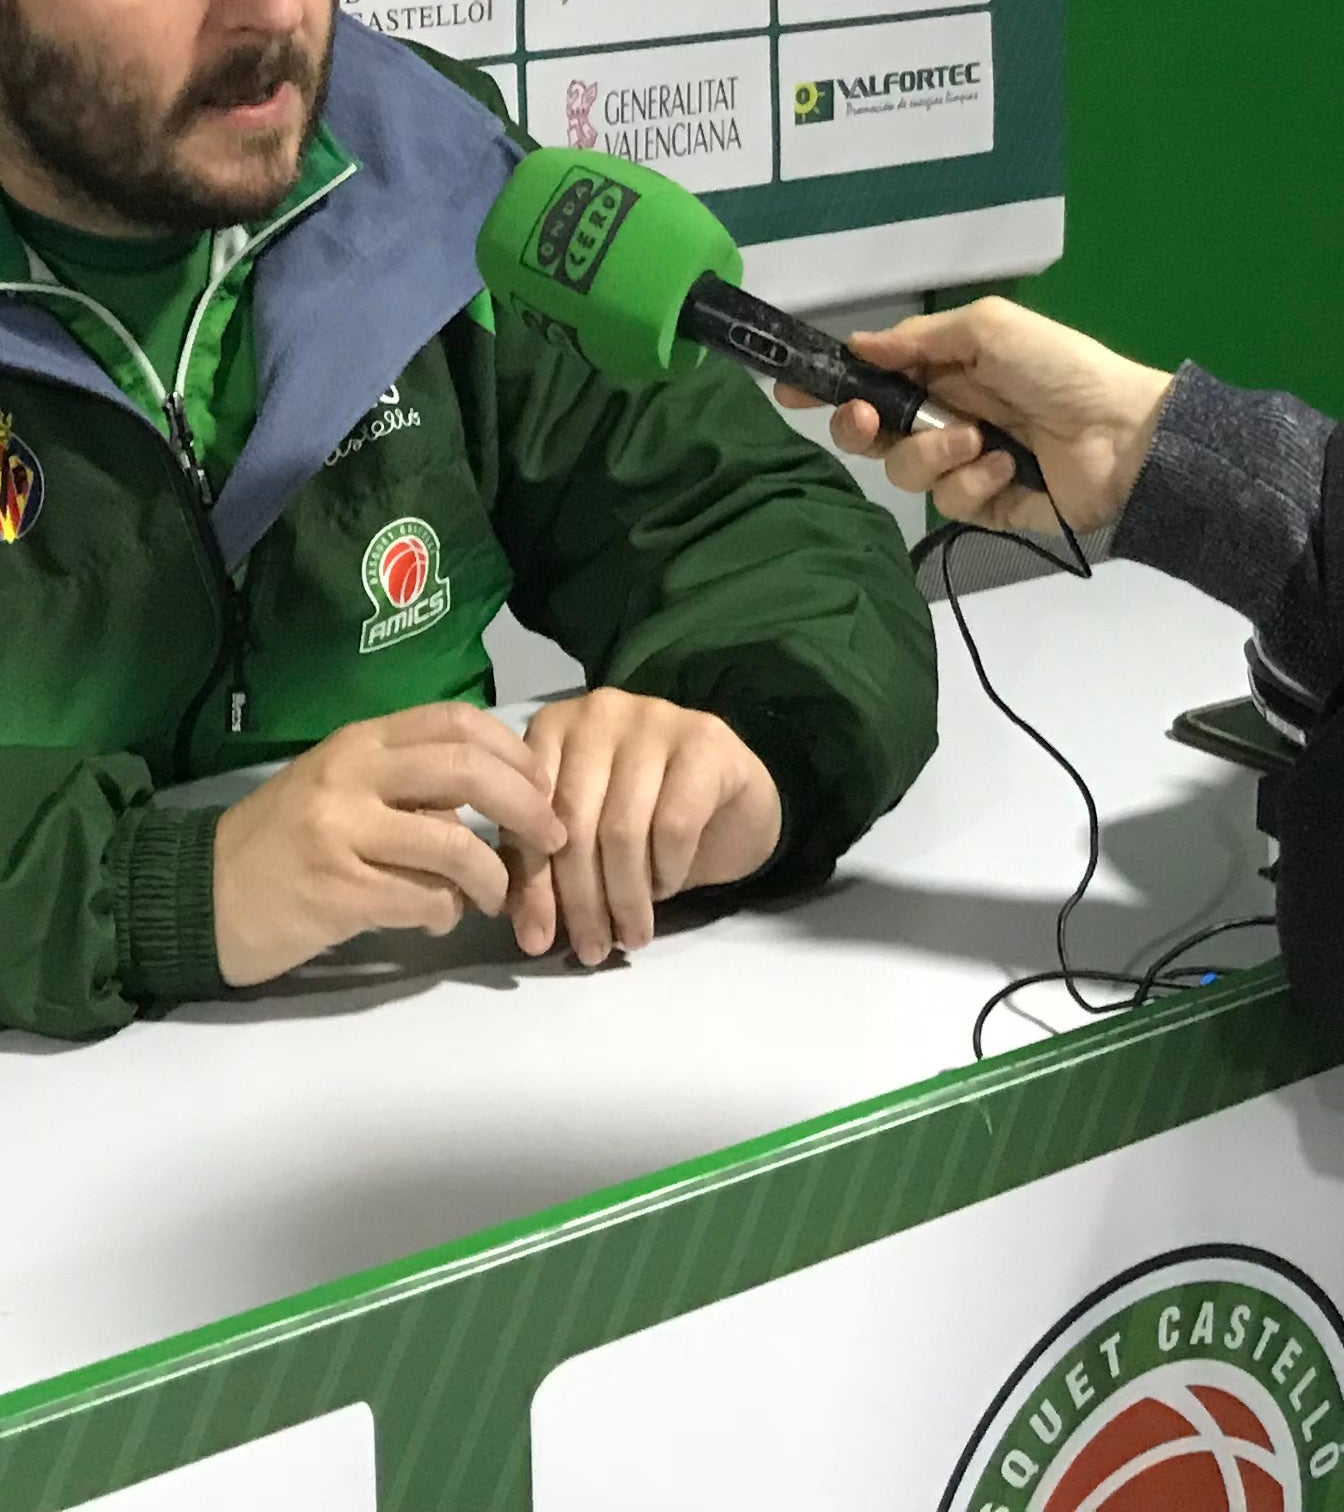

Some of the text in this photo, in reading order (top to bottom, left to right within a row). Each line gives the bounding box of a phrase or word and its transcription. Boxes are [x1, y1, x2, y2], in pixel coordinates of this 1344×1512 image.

[604, 77, 738, 125] GENERALITAT
[837, 62, 980, 99] VALFORTEC
[605, 119, 741, 162] VALENCIANA
[368, 589, 444, 646] AMICS
[979, 1332, 1123, 1512] QUET
